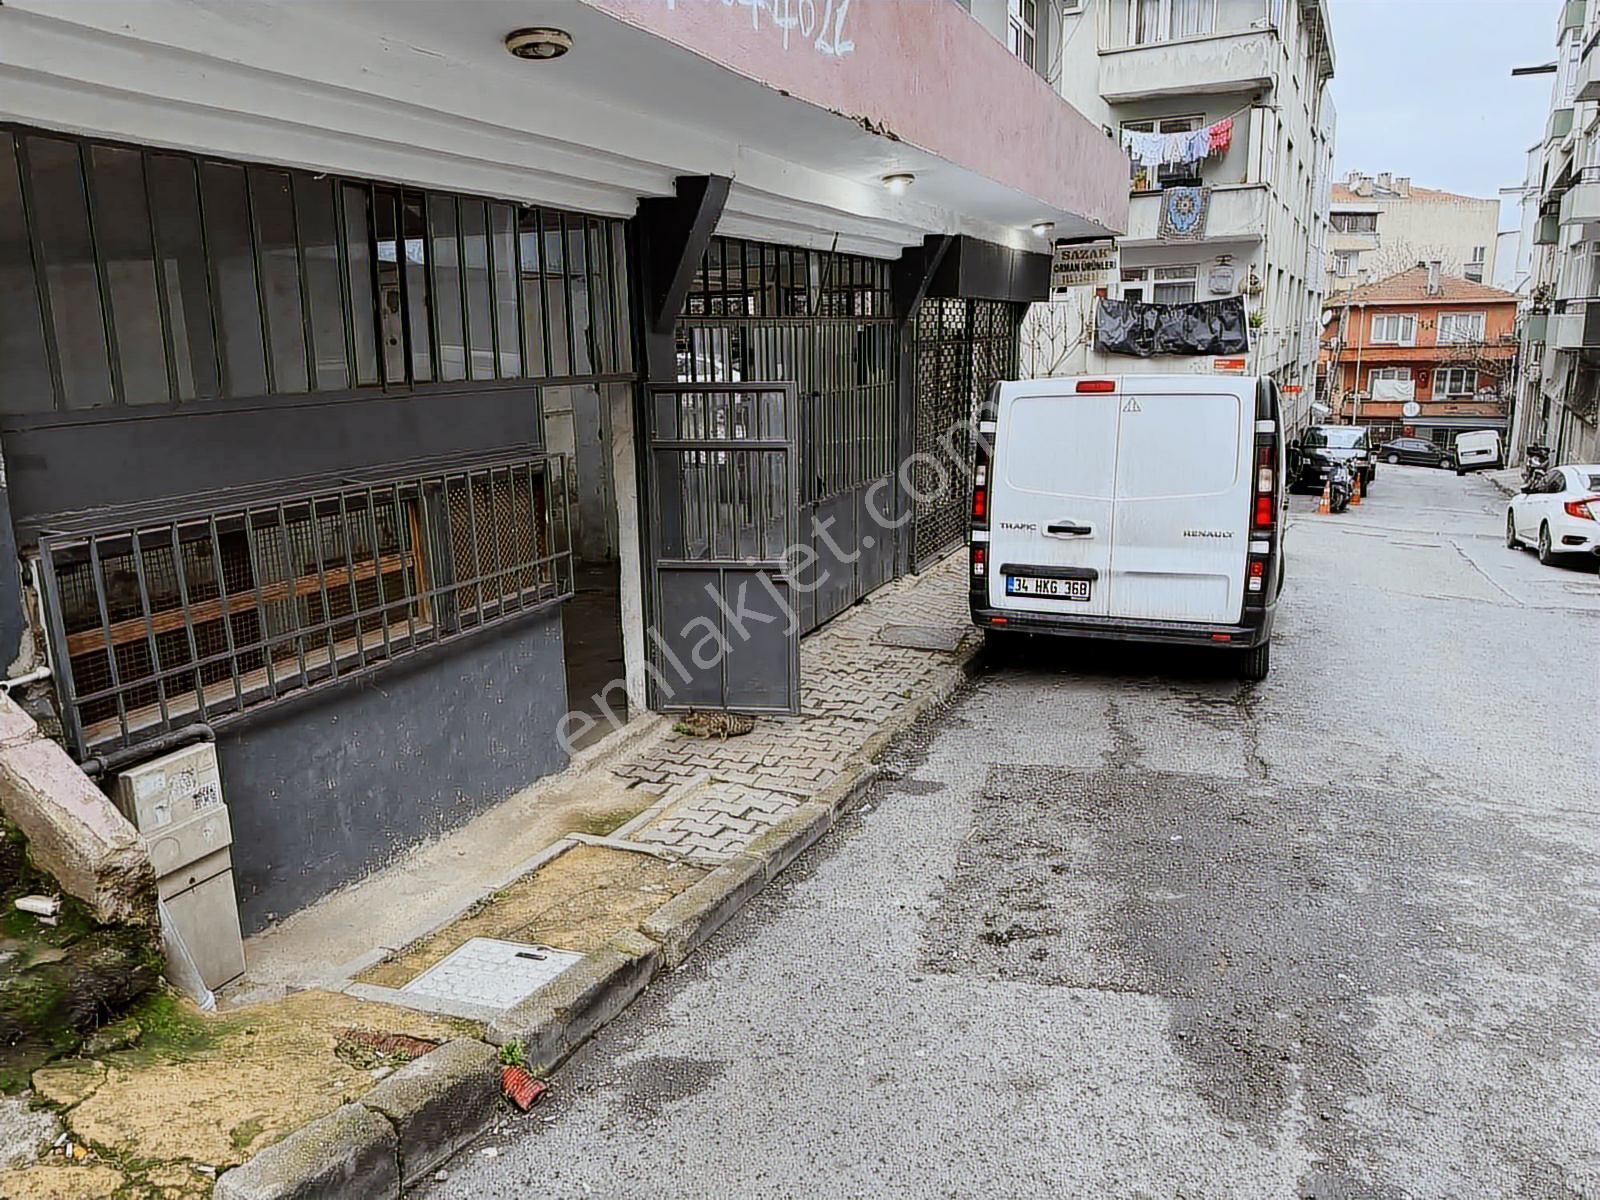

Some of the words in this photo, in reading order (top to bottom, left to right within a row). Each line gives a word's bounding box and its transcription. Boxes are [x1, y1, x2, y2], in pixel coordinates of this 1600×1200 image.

[1000, 522, 1037, 531] TRAFIC
[1183, 530, 1235, 538] RENAULT
[1014, 578, 1028, 592] 34
[1035, 580, 1057, 594] HKG
[1065, 582, 1087, 596] 368
